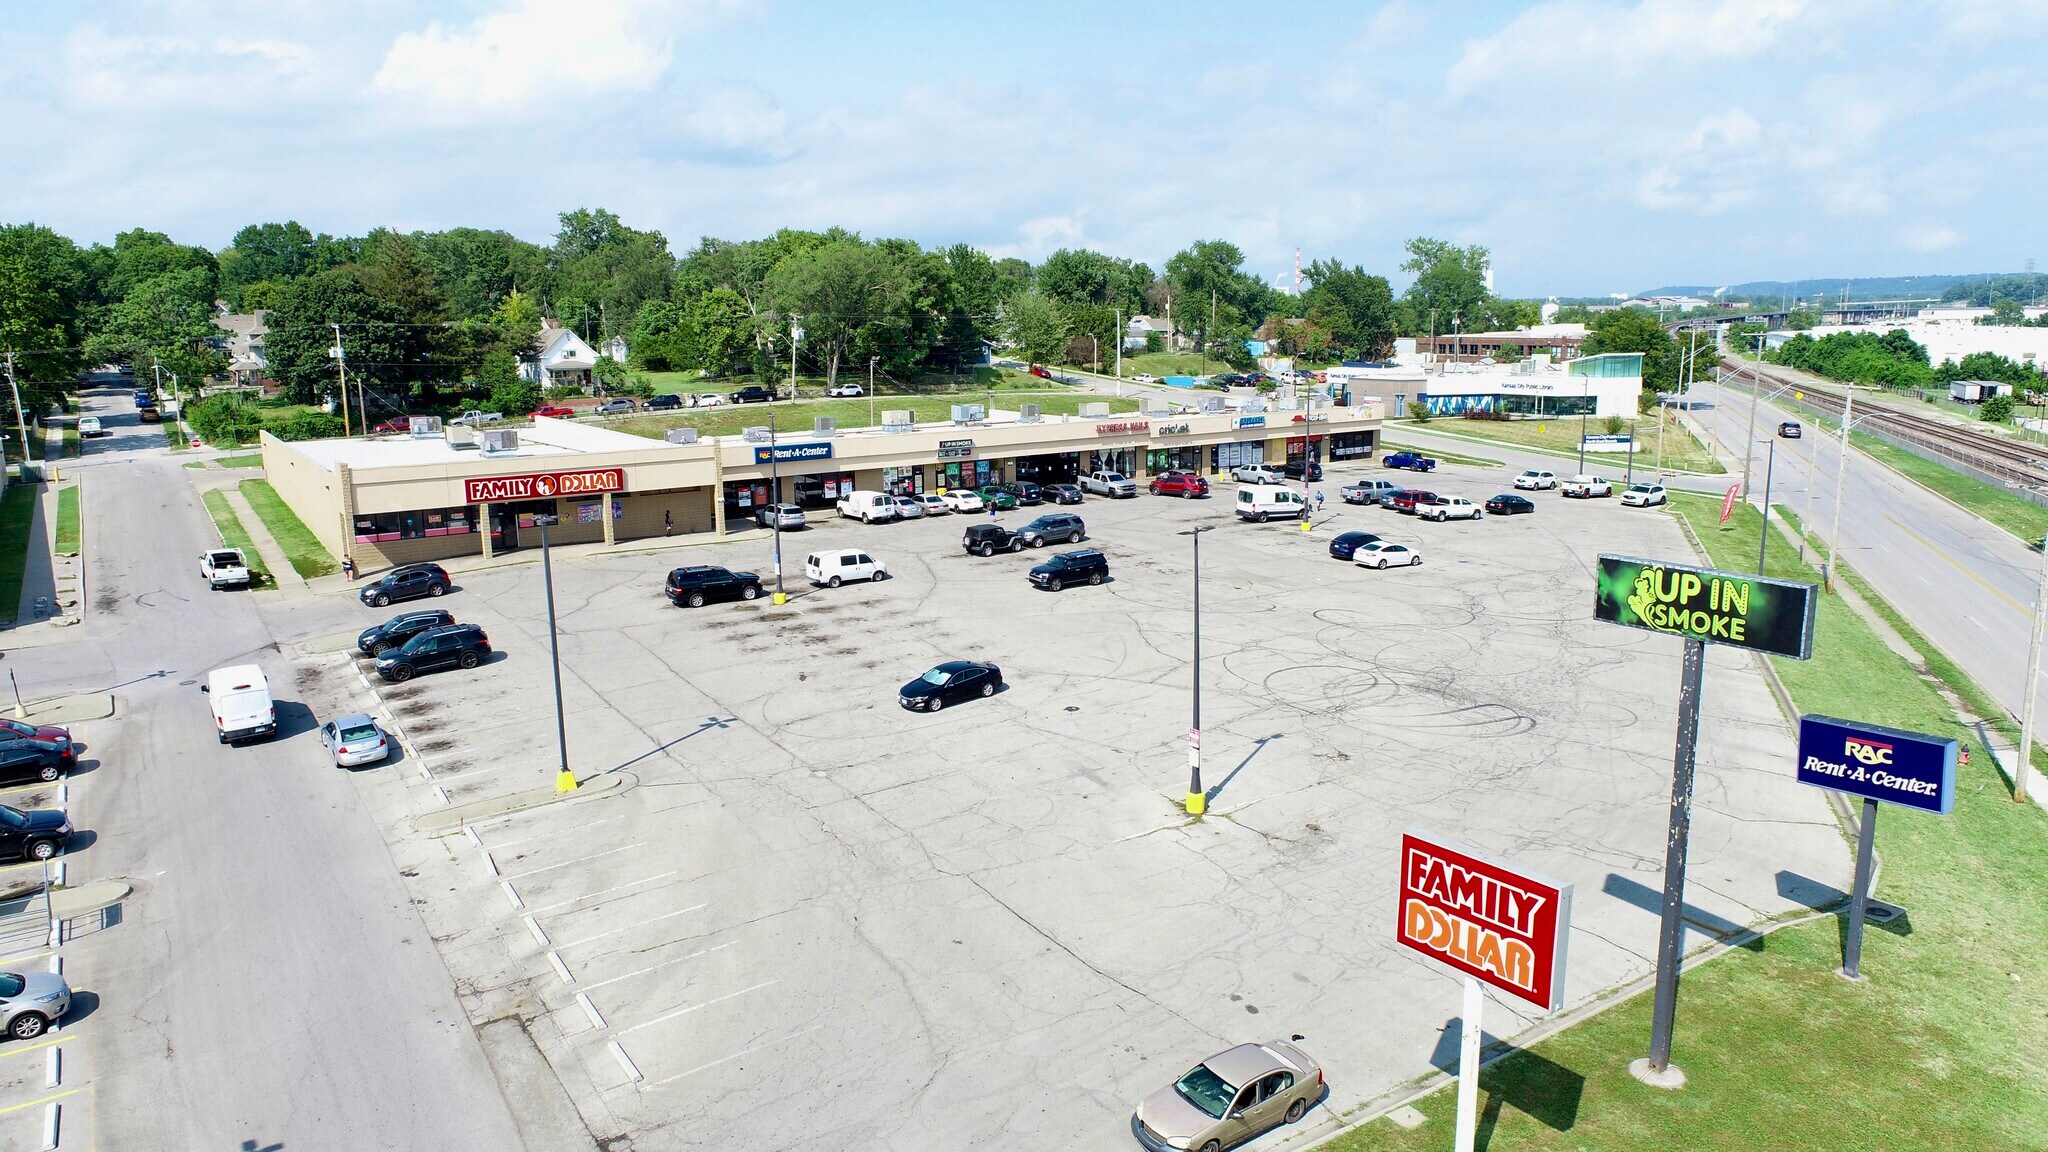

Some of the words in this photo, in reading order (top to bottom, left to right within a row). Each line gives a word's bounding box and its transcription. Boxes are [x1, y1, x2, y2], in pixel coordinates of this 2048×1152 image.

[1159, 422, 1190, 435] cricket
[470, 478, 533, 500] FAMILY
[560, 471, 618, 493] DOLLAR
[1655, 567, 1702, 605] UP
[1709, 578, 1750, 616] IN
[1653, 604, 1747, 641] SMOKE
[1845, 741, 1893, 764] RAC
[1407, 848, 1546, 938] FAMILY
[1405, 899, 1535, 992] DOLLAR
